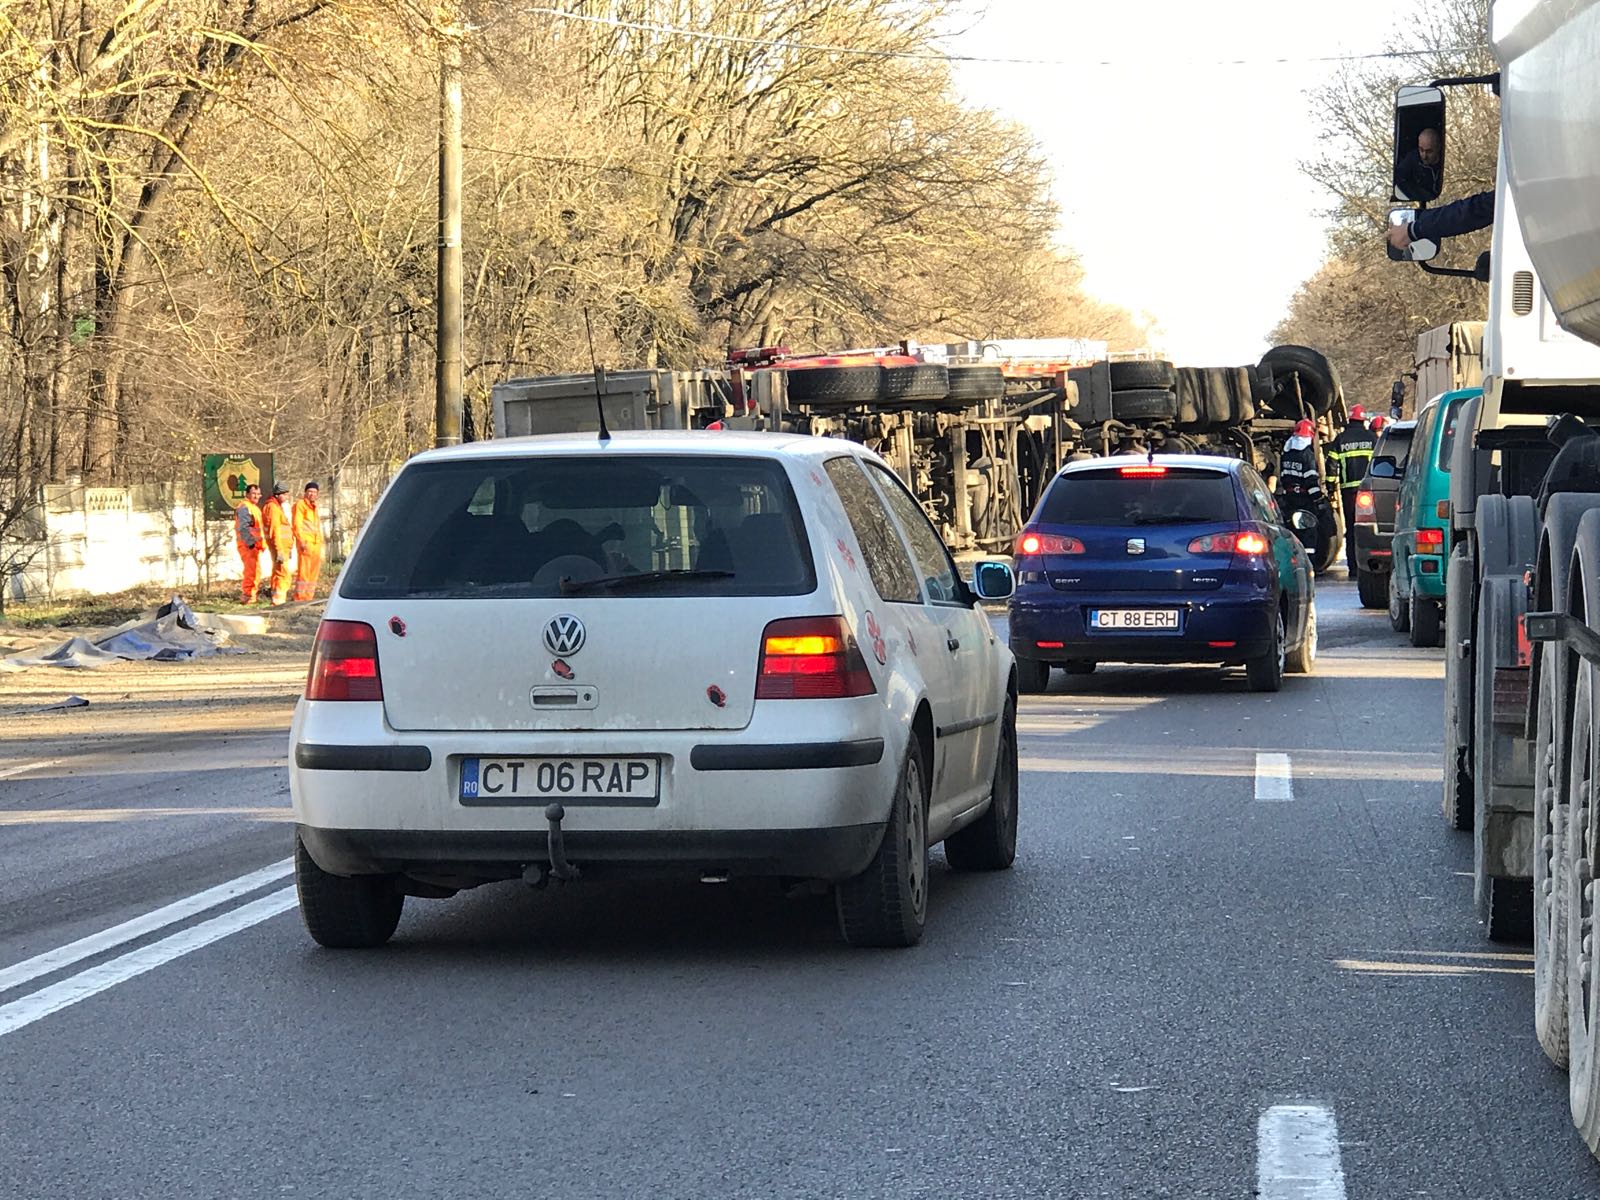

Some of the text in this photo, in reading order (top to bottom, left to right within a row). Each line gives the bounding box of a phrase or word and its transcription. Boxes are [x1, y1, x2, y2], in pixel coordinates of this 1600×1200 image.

[1099, 612, 1118, 626] CT
[1124, 612, 1141, 626] 88
[1144, 612, 1176, 626] ERH
[463, 762, 649, 793] RO CT 06 RAP
